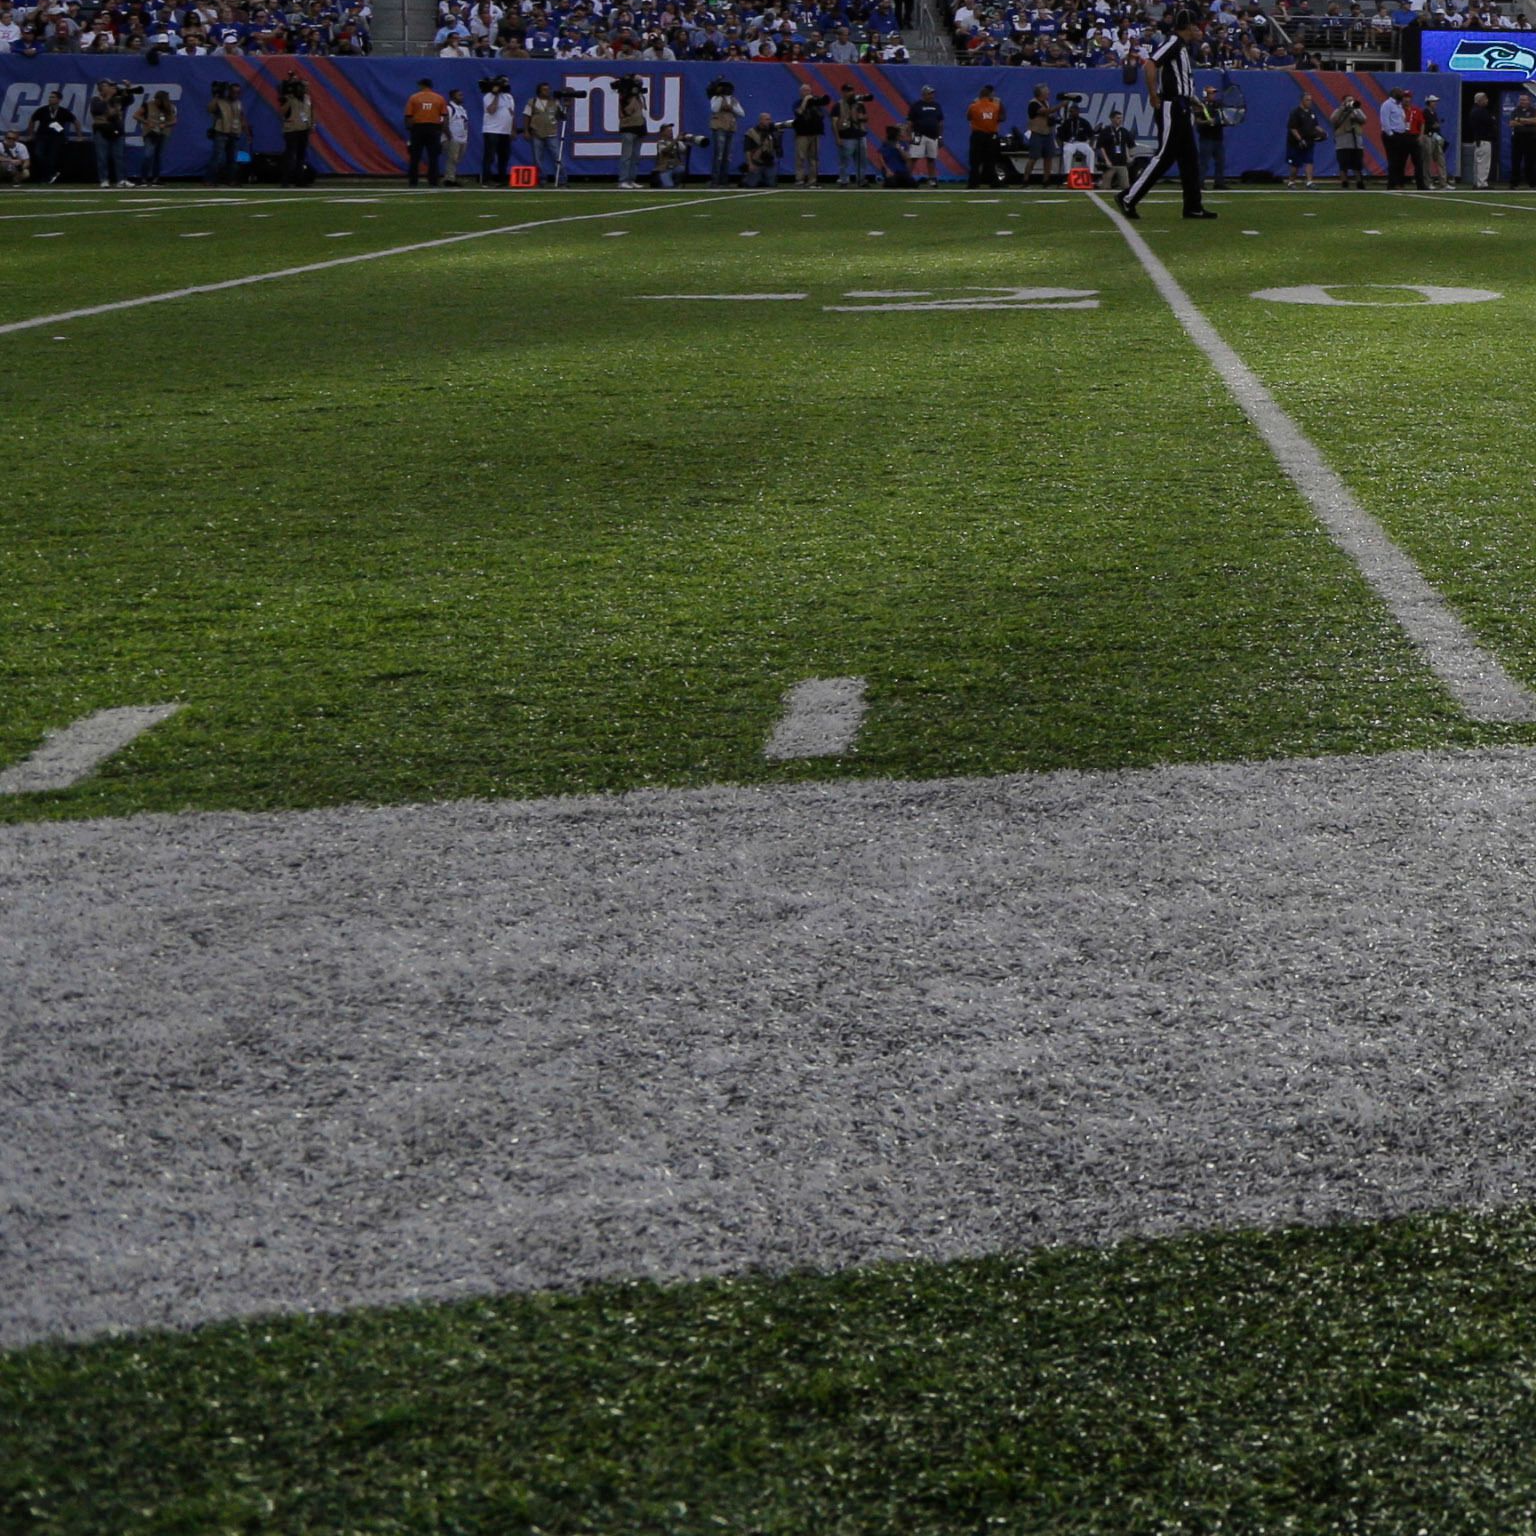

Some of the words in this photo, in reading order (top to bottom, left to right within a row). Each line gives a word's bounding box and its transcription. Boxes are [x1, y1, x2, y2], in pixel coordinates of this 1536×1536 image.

[565, 75, 681, 157] ny
[514, 168, 532, 185] 10
[1072, 173, 1089, 186] 20
